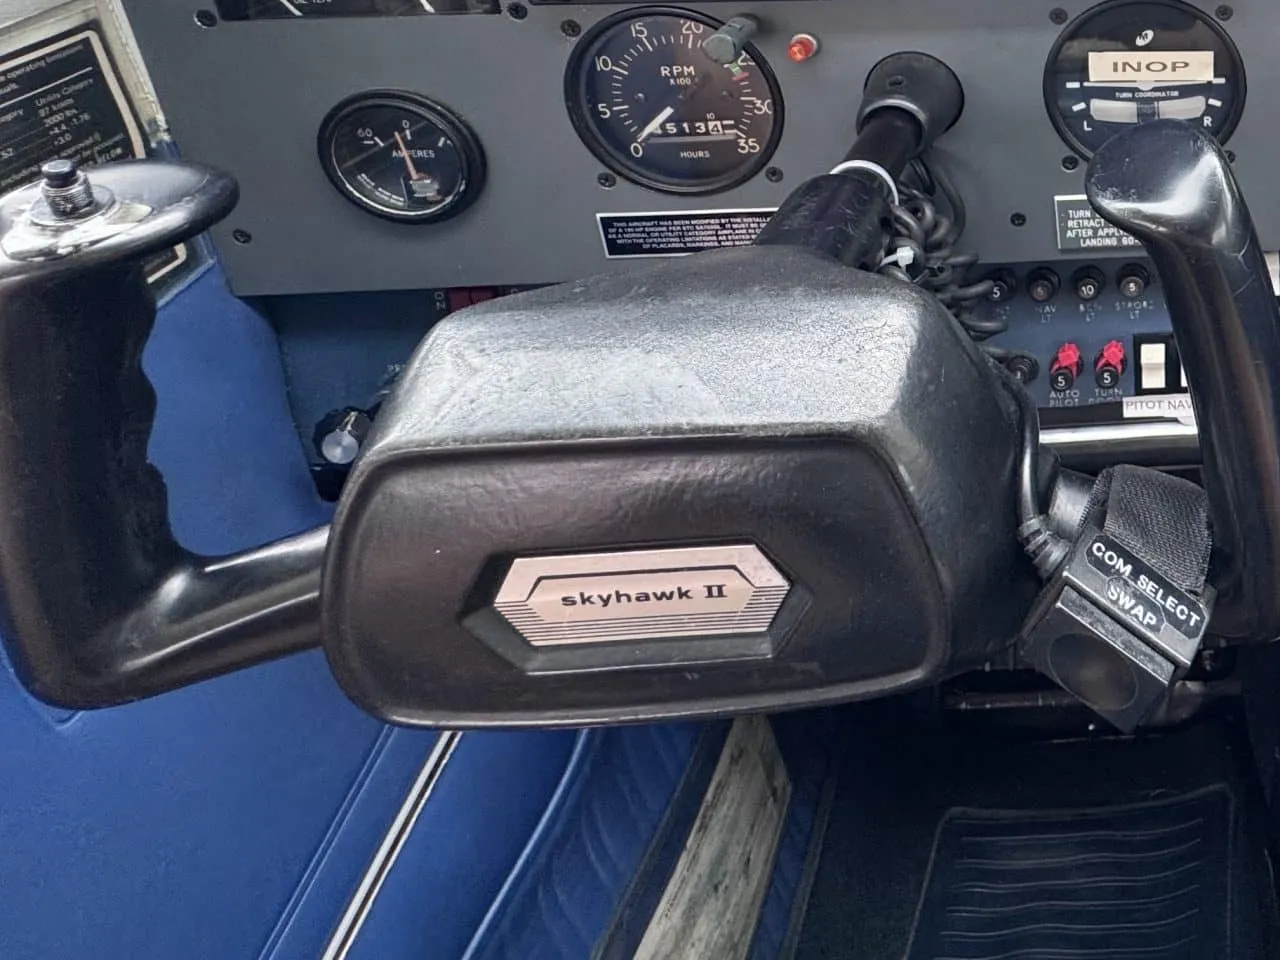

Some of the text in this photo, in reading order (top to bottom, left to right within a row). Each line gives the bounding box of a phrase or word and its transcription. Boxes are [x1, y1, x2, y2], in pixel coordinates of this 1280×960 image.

[630, 22, 648, 39] 15
[660, 65, 696, 76] RPM
[1112, 60, 1190, 73] INOP
[597, 103, 611, 118] 5
[737, 139, 760, 154] 35
[680, 151, 710, 159] HOURS
[1067, 228, 1093, 238] AFTER
[1057, 375, 1066, 387] 5
[1103, 372, 1112, 384] 5
[1048, 390, 1080, 399] AUTO
[1125, 400, 1163, 410] PITOT
[1091, 541, 1200, 628] COM SELECT
[560, 584, 727, 608] skyhawk II
[1106, 585, 1158, 627] SWAP
